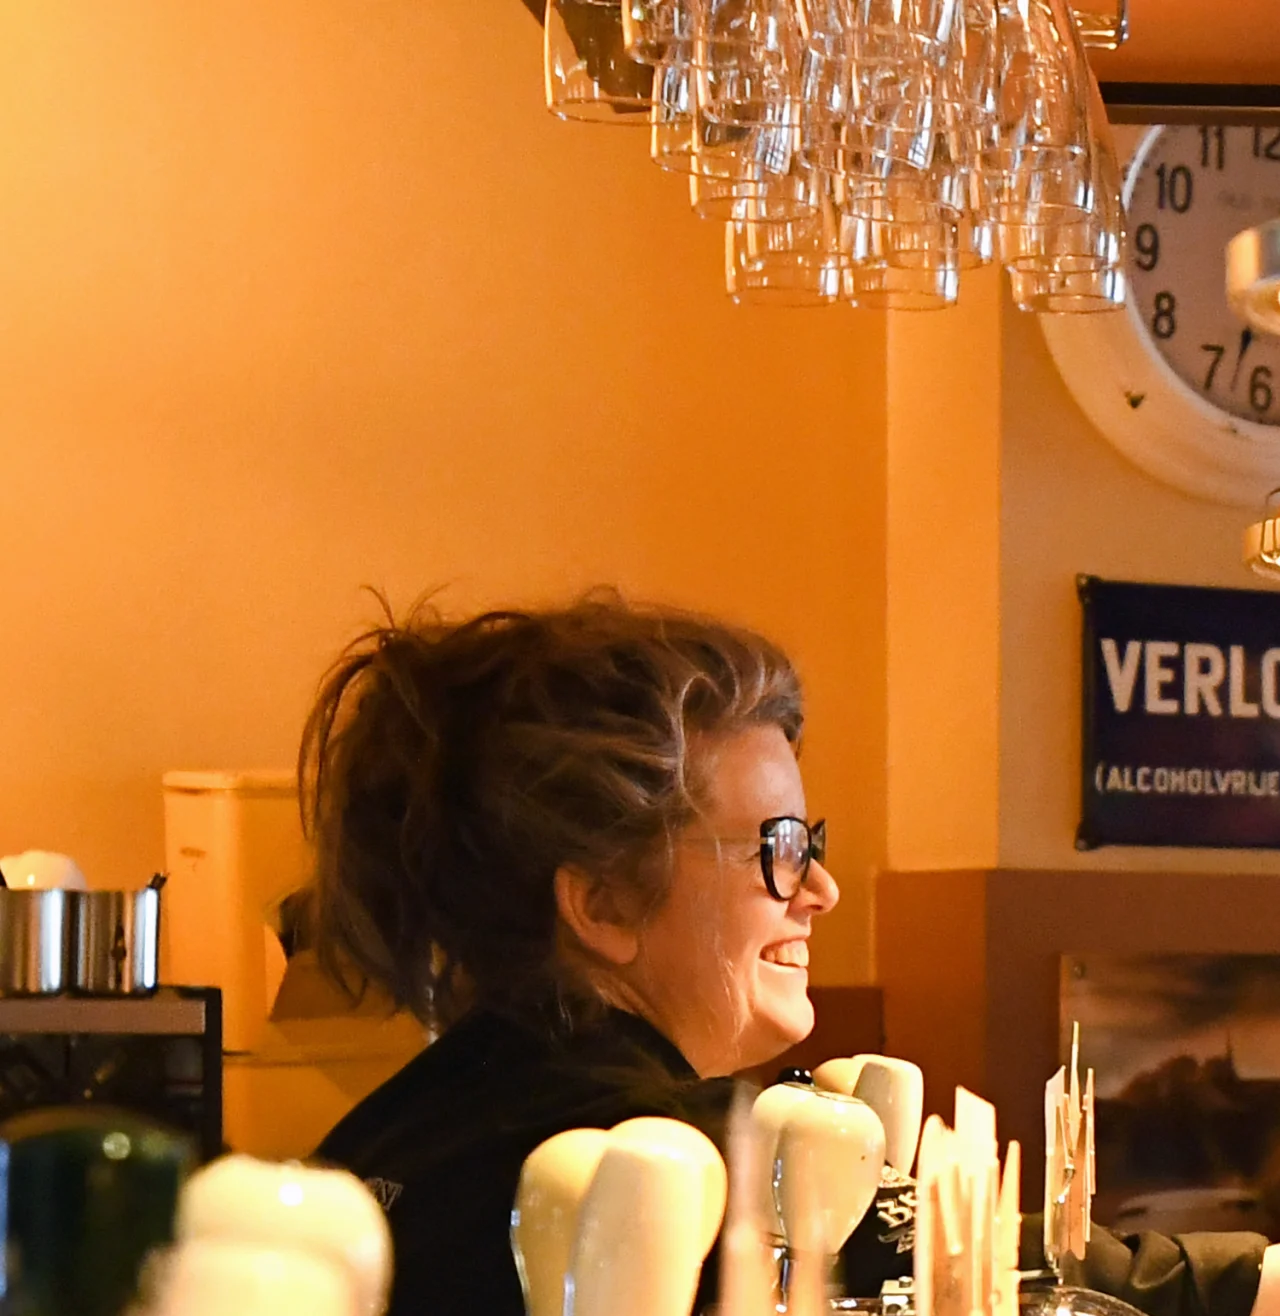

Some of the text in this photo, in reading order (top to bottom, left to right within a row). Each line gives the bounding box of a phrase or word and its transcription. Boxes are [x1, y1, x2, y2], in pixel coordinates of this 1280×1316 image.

[1156, 164, 1194, 213] 10
[1135, 224, 1160, 271] 9
[1152, 292, 1176, 339] 8
[1201, 344, 1224, 391] 7
[1249, 366, 1272, 412] 6
